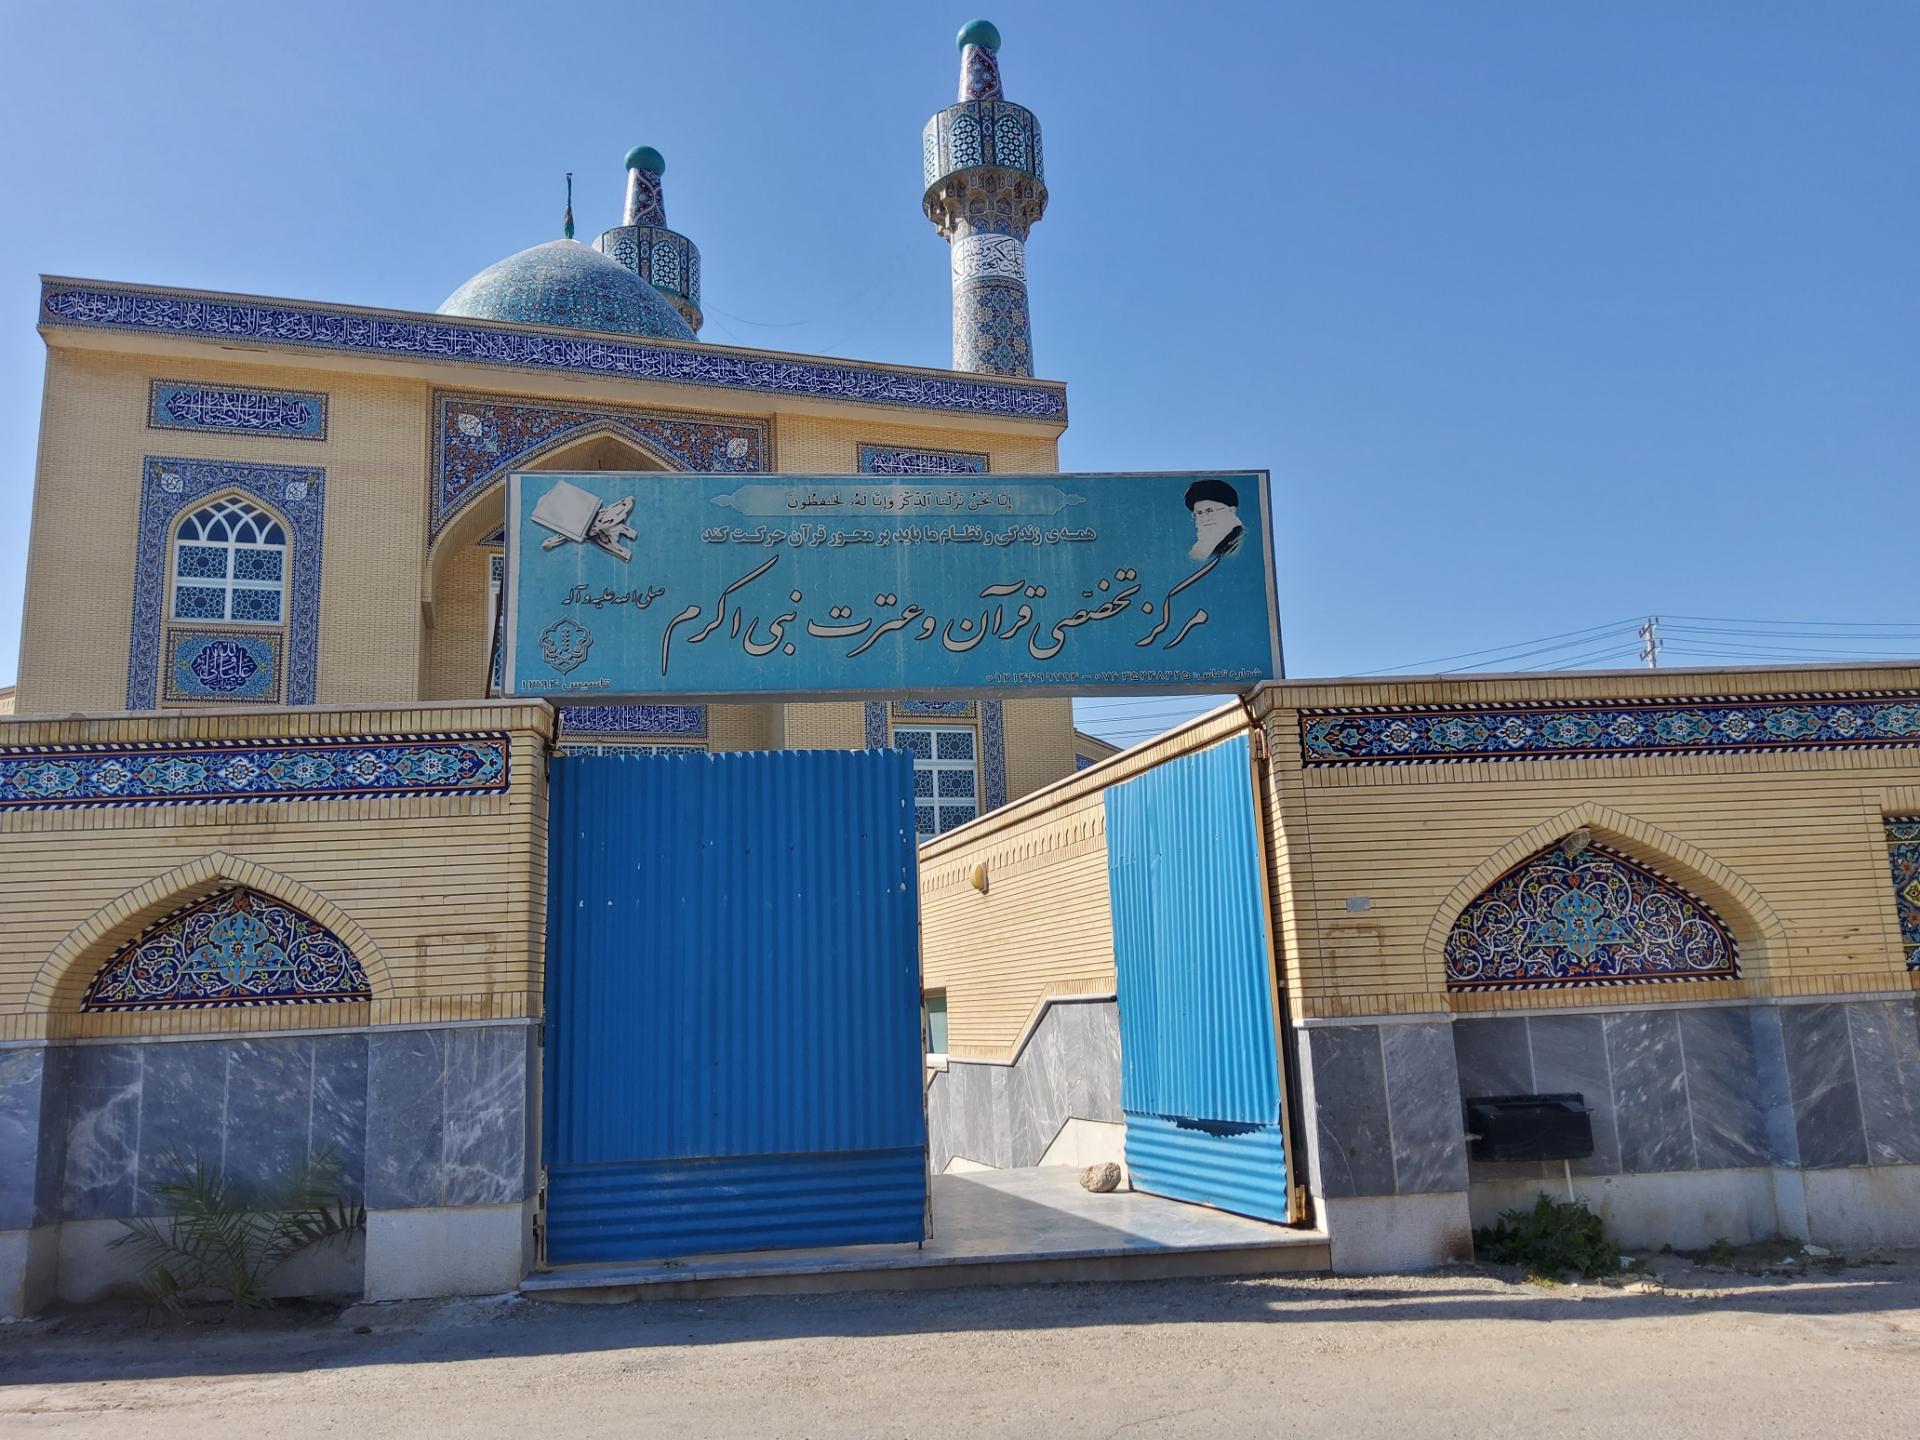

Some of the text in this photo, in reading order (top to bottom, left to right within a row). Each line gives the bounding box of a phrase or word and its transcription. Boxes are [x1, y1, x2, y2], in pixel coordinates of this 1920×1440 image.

[701, 525, 729, 543] کند
[730, 525, 786, 547] حرکت
[787, 523, 827, 547] قرآن
[828, 527, 874, 548] محور
[875, 528, 890, 547] بر
[893, 524, 922, 545] باید
[923, 525, 938, 542] ما
[939, 524, 983, 545] نظام
[983, 530, 994, 546] و
[994, 524, 1042, 546] زندگی
[1136, 555, 1221, 650] مرکز
[662, 554, 779, 677] اکرم
[743, 589, 803, 656] نبی
[808, 593, 924, 658] عترت
[942, 580, 1047, 652] قرآن
[914, 615, 936, 641] و
